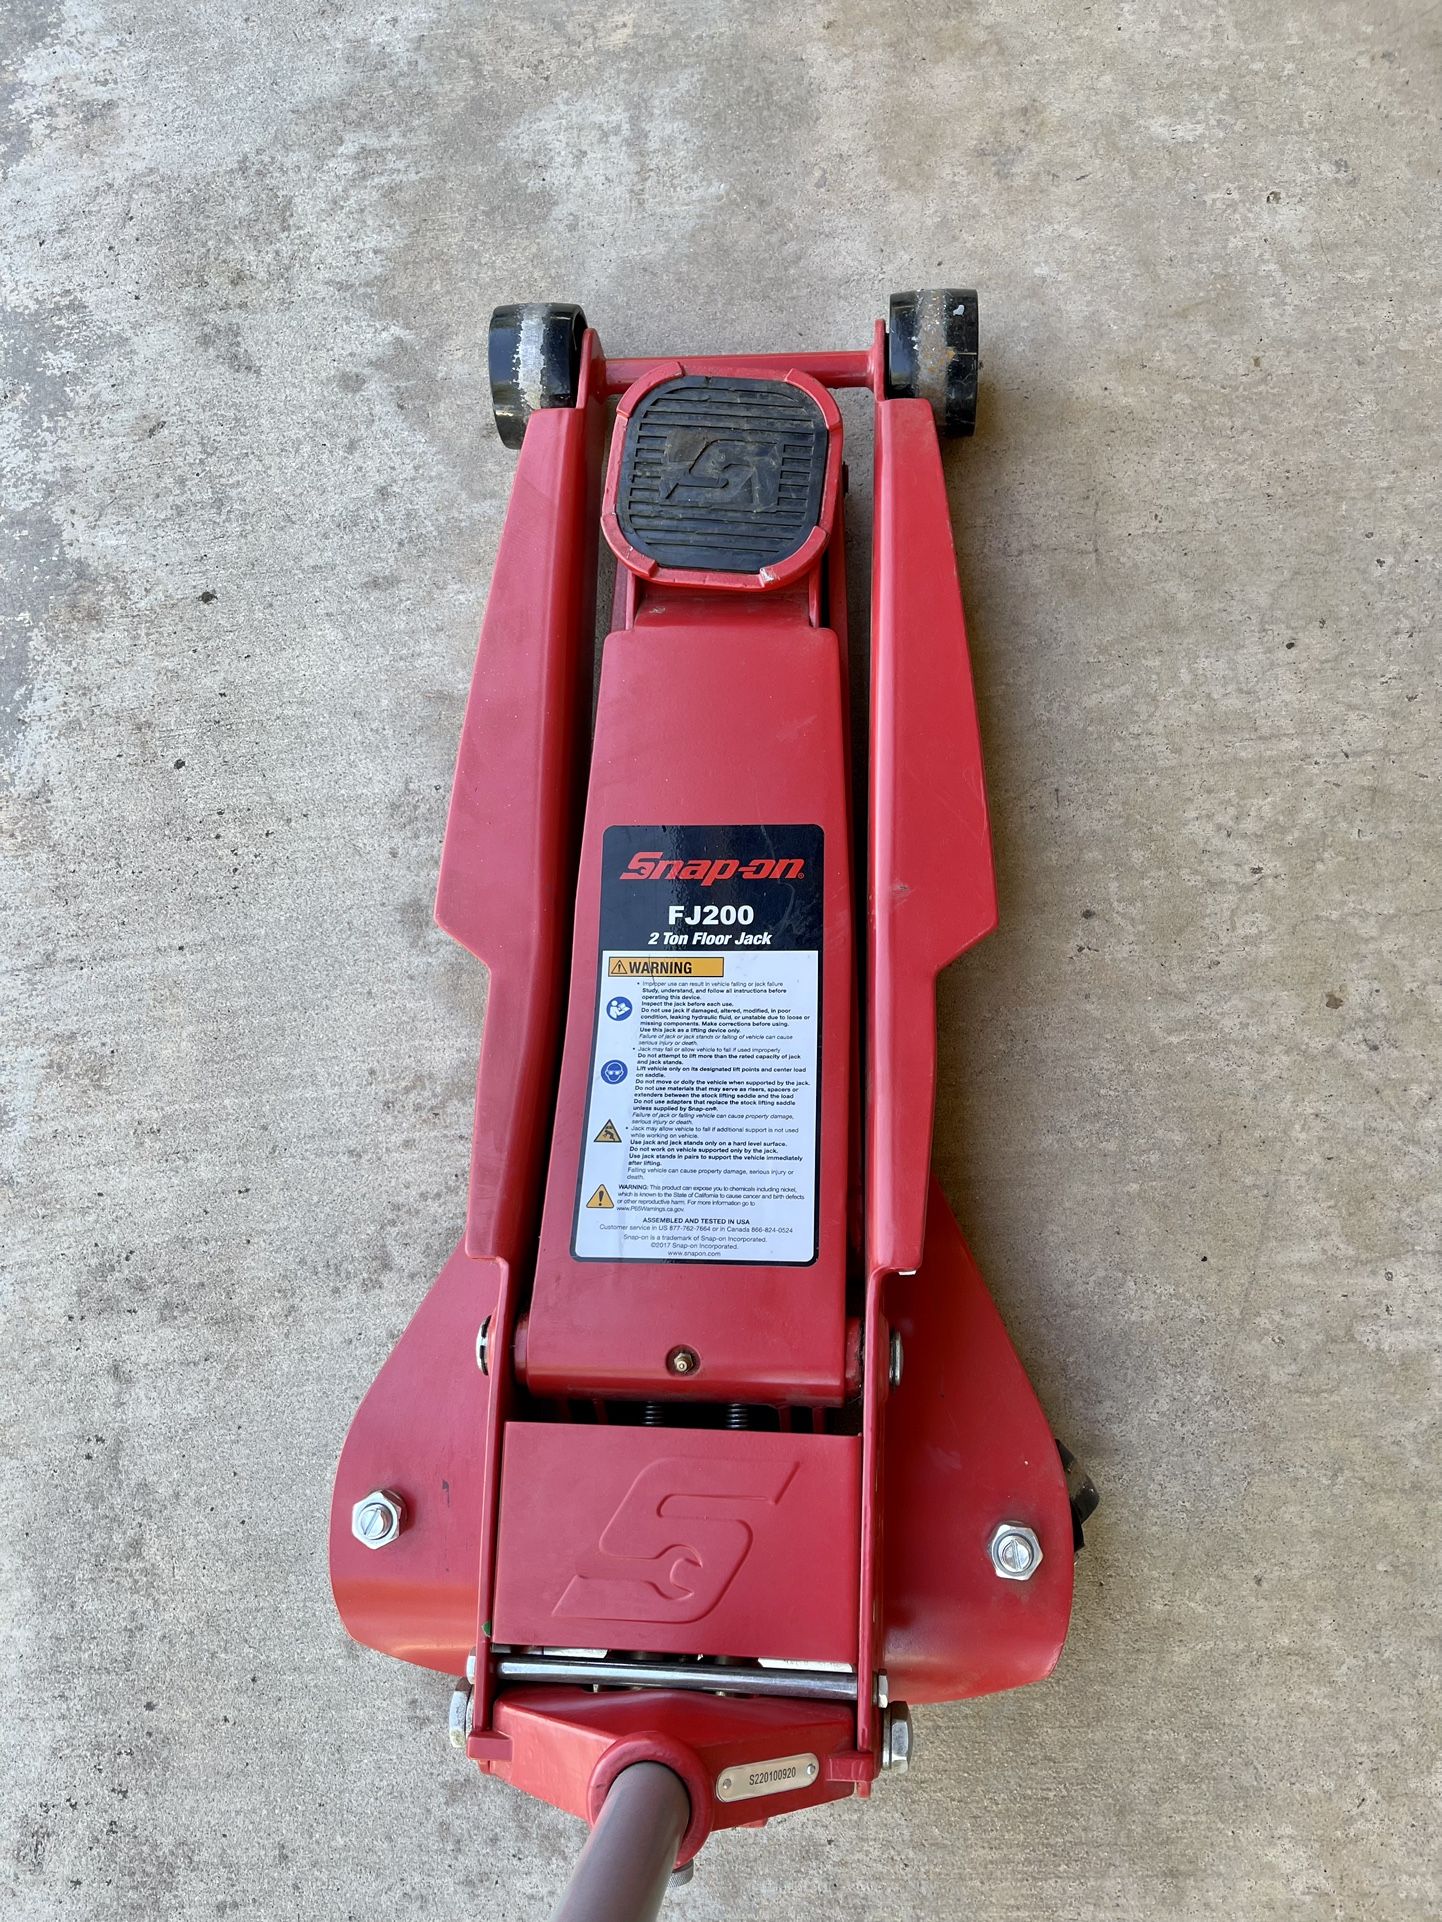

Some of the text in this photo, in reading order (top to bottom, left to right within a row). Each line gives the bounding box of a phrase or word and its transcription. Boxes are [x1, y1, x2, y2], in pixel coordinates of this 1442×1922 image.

[668, 905, 755, 925] FJ200
[648, 932, 773, 945] 2 Ton Floor Jack
[629, 961, 692, 974] WARNING
[749, 1766, 797, 1786] S220100920
